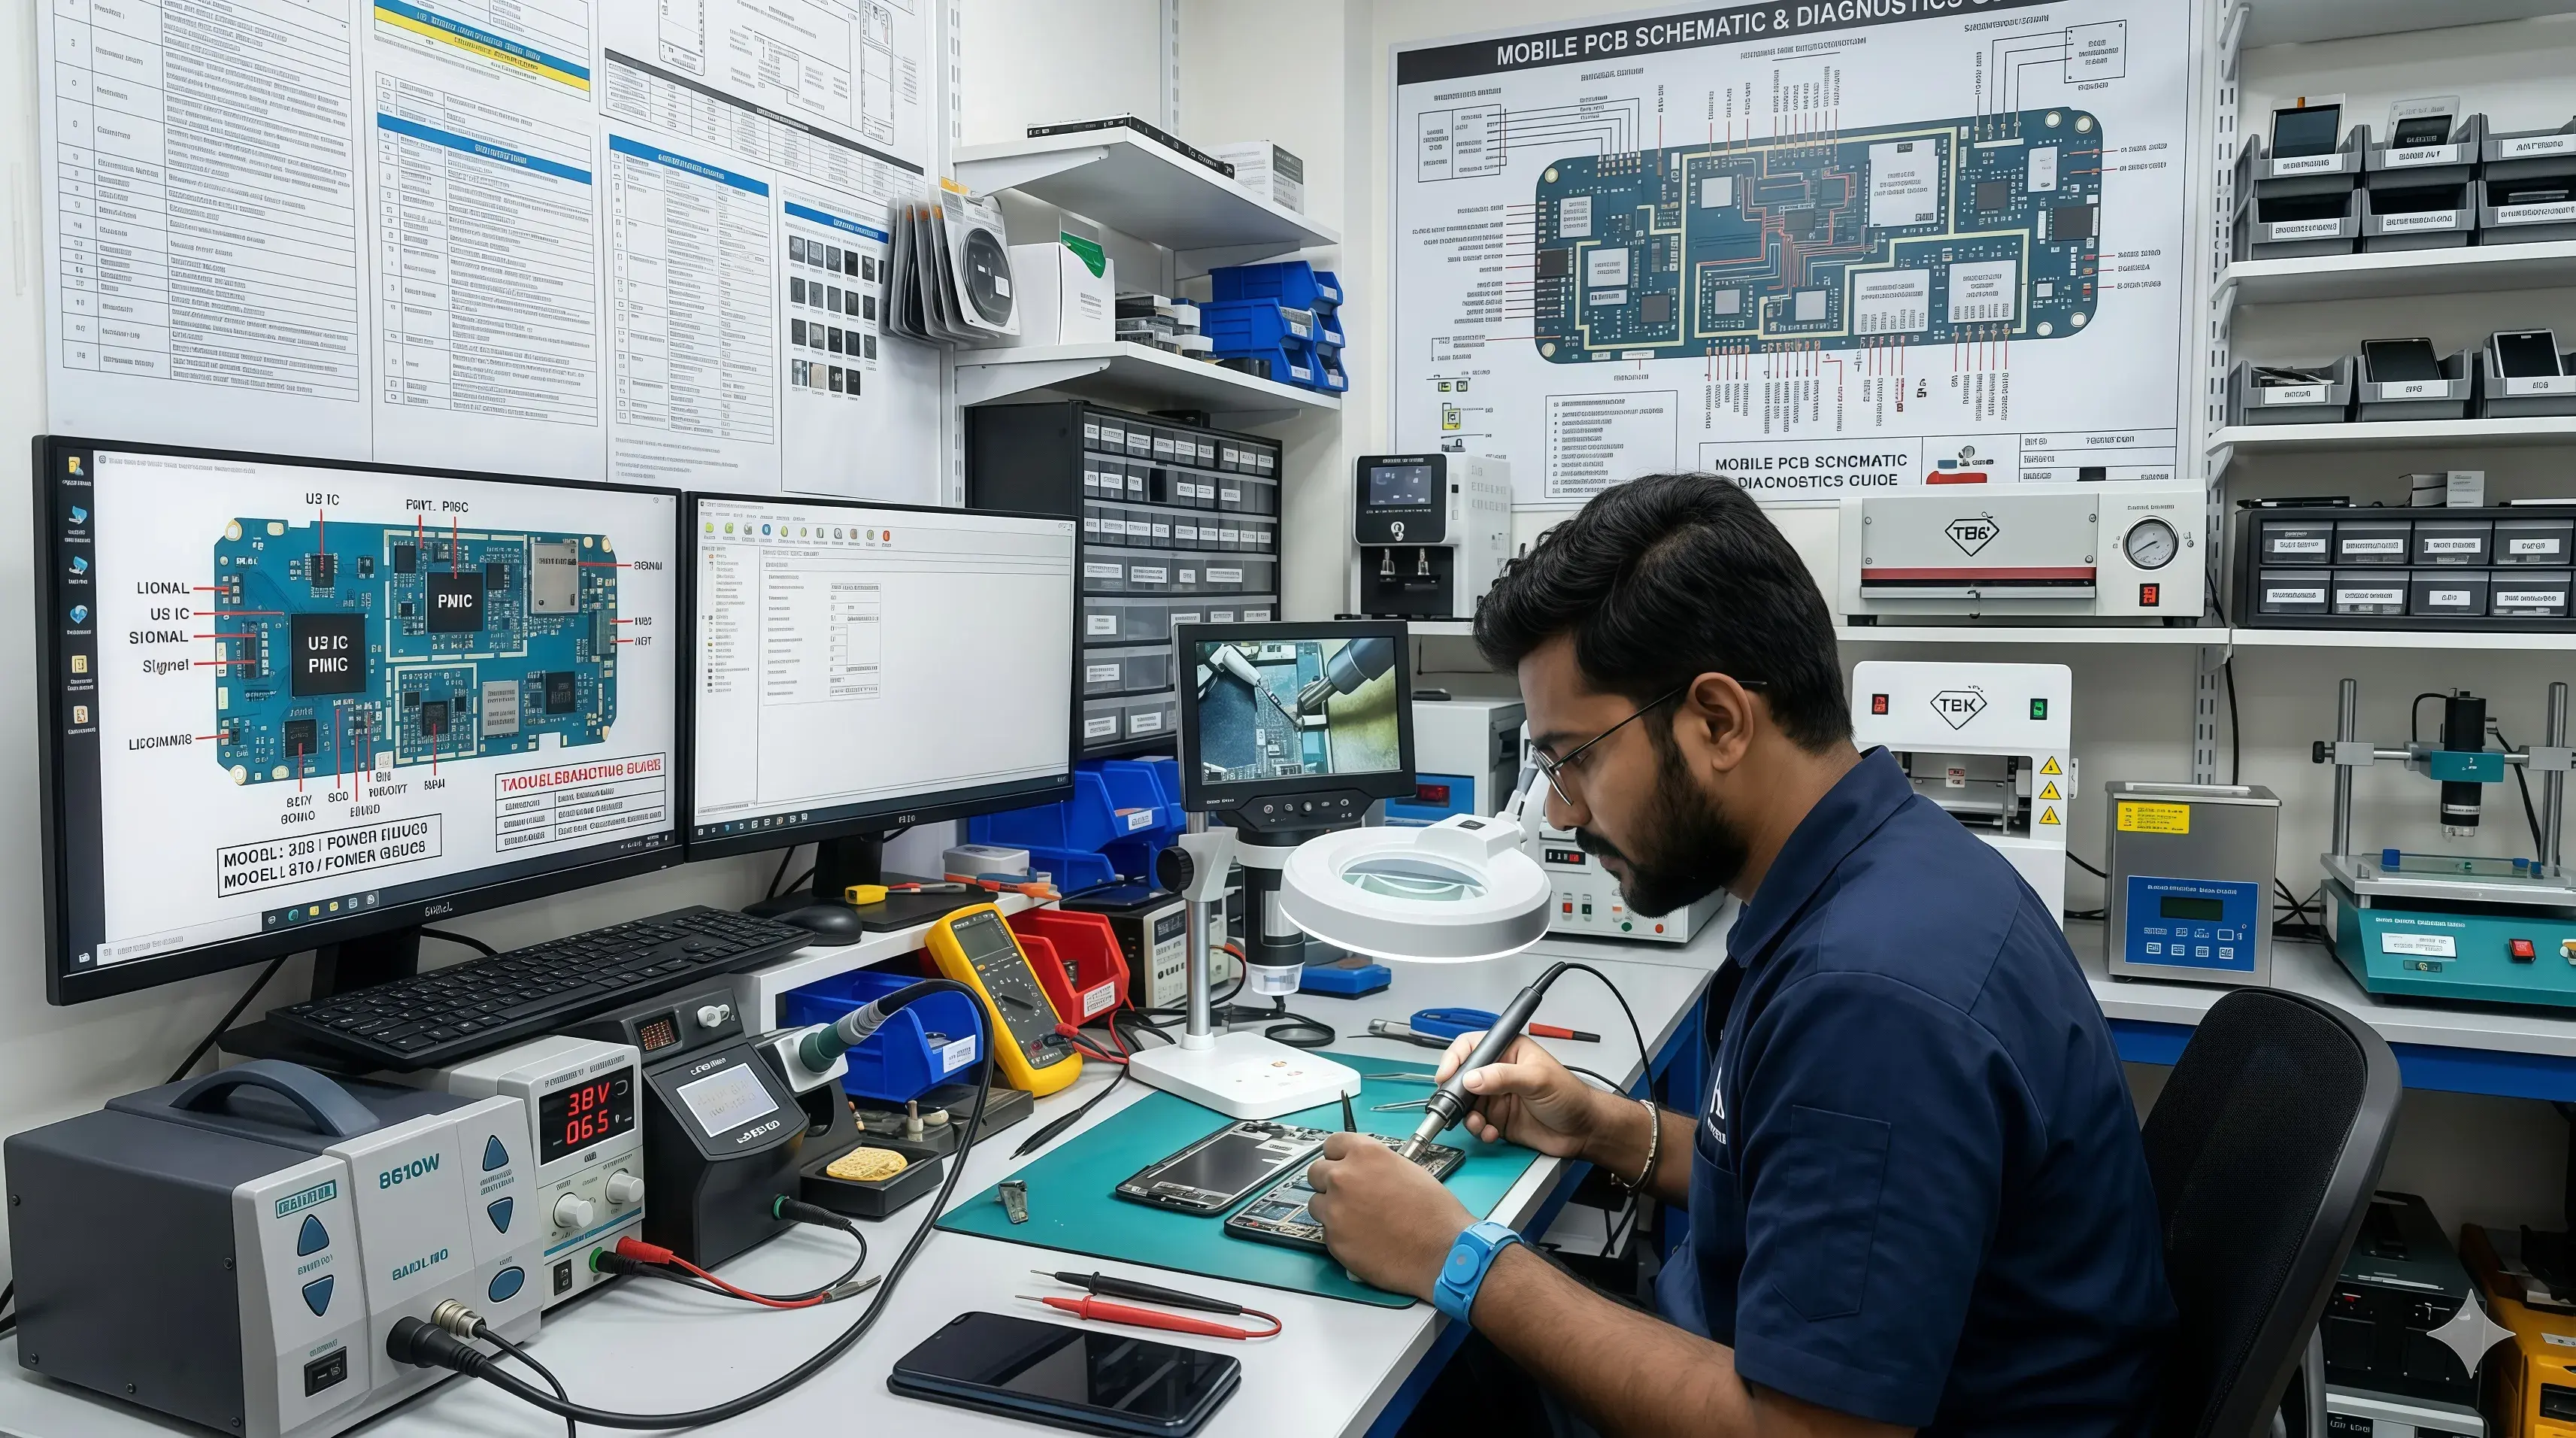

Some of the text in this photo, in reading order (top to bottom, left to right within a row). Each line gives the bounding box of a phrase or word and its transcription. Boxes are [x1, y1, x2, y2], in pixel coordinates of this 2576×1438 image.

[1497, 36, 1577, 65] MOBILE
[1585, 29, 1629, 54] PCB
[1635, 11, 1765, 47] SCHEMATIC
[1773, 8, 1790, 30] &
[1778, 457, 1809, 469] PCB
[137, 581, 190, 594] LIONAL
[150, 607, 189, 620] US IC
[379, 1152, 441, 1190] 8610W
